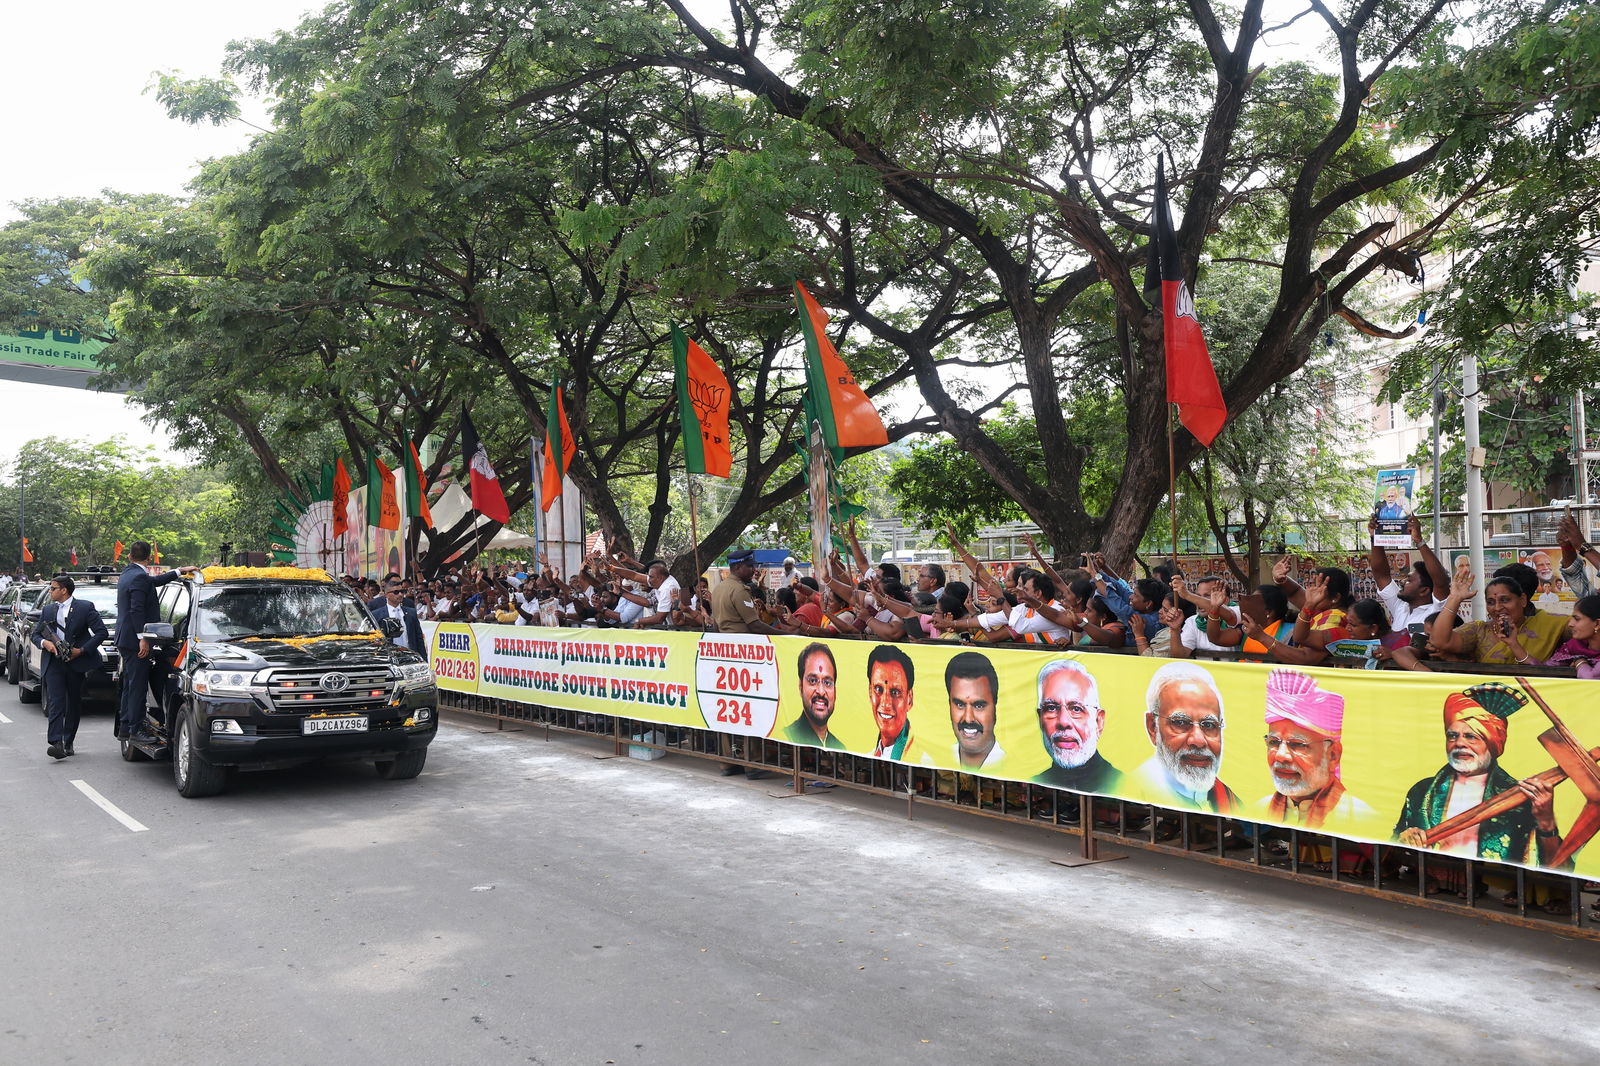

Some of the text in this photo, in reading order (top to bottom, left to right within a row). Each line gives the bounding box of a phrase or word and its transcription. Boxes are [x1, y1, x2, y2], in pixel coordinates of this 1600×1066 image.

[25, 345, 59, 357] Trade
[63, 351, 85, 360] Fair
[439, 633, 470, 651] BIHAR
[494, 637, 668, 668] BHARATIYA JANATA PARTY
[699, 642, 774, 661] TAMILNADU
[435, 657, 476, 680] 202/243
[716, 666, 763, 692] 200+
[484, 665, 689, 707] COIMBATORE SOUTH DISTRICT
[717, 699, 752, 726] 234
[310, 720, 367, 732] DL2CAX2964
